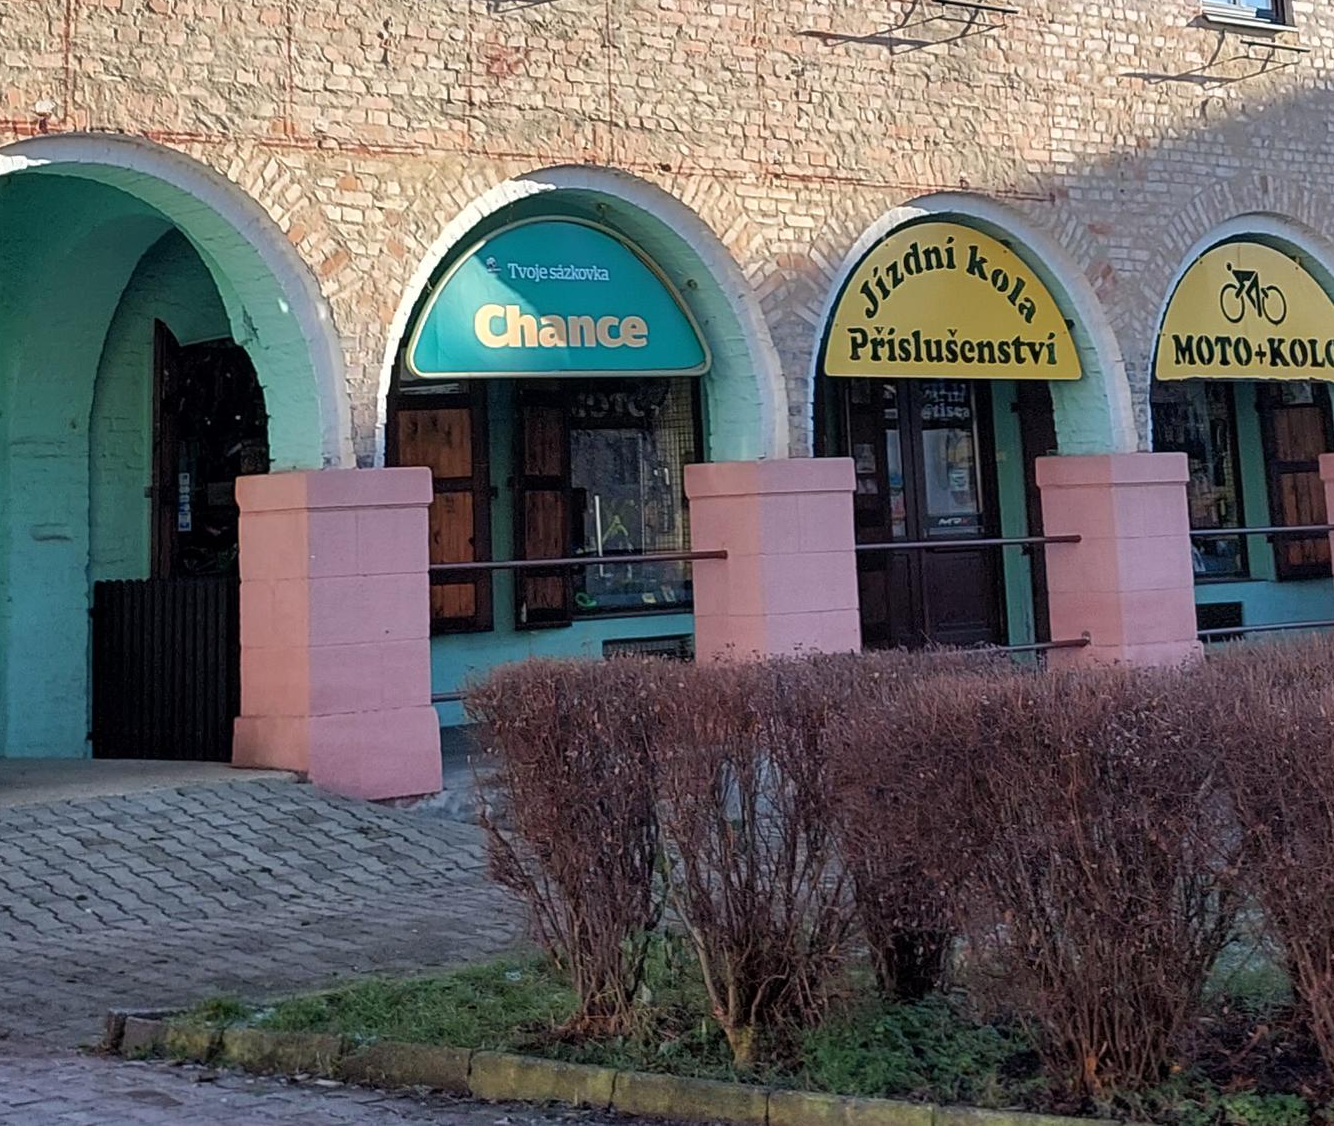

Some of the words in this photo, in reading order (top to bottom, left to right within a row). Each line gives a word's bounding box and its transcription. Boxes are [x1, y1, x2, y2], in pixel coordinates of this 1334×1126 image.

[507, 263, 549, 282] Tvoje
[549, 265, 610, 281] sázkovka
[860, 236, 957, 319] Jízdní
[966, 245, 1037, 324] kola
[474, 304, 649, 349] Chance
[847, 326, 1058, 365] Příslušenství
